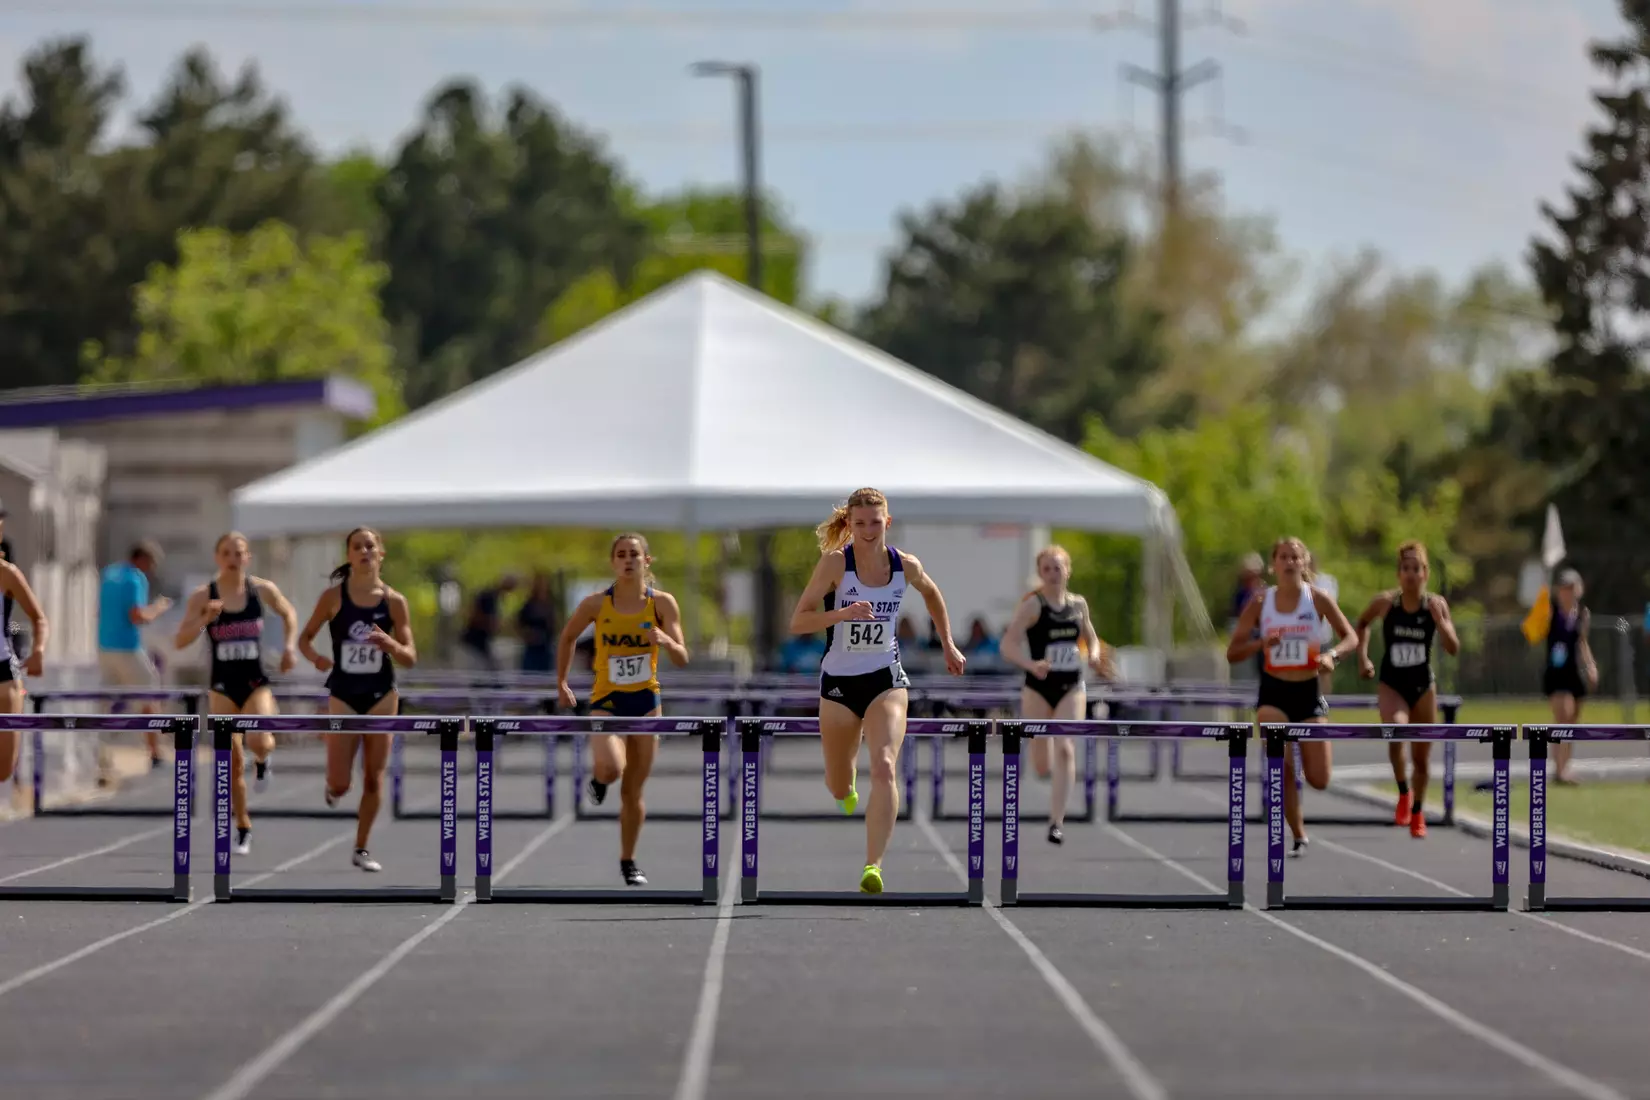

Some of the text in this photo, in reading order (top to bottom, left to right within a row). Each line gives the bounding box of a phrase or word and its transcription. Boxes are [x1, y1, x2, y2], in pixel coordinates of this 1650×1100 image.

[875, 601, 901, 613] STATE
[850, 623, 884, 645] 542
[349, 645, 377, 665] 264
[616, 657, 644, 677] 357
[148, 719, 171, 728] GILL
[236, 720, 258, 728] GILL
[413, 721, 437, 729] GILL
[497, 721, 520, 730] GILL
[675, 722, 698, 730] GILL
[763, 722, 786, 730] GILL
[942, 724, 964, 732] GILL
[1024, 724, 1047, 733] GILL
[1202, 727, 1225, 736] GILL
[1288, 728, 1311, 736] GILL
[1466, 729, 1489, 737] GILL
[1551, 729, 1574, 738] GILL
[177, 760, 188, 794] STATE
[217, 760, 228, 794] STATE
[443, 761, 454, 795] STATE
[479, 762, 490, 796] STATE
[745, 763, 756, 797] STATE
[971, 764, 982, 799] STATE
[1005, 764, 1016, 799] STATE
[1231, 767, 1242, 801] STATE
[1271, 768, 1282, 802] STATE
[1496, 769, 1507, 804] STATE
[1532, 769, 1543, 804] STATE
[177, 798, 188, 838] WEBER
[217, 798, 228, 839] WEBER
[706, 762, 716, 841] WEBER STATE
[443, 799, 454, 839] WEBER
[479, 800, 490, 840] WEBER
[745, 800, 756, 841] WEBER
[971, 802, 982, 842] WEBER
[1005, 802, 1016, 843] WEBER
[1231, 805, 1242, 845] WEBER
[1271, 805, 1282, 845] WEBER
[1496, 807, 1507, 848] WEBER
[1532, 807, 1543, 848] WEBER
